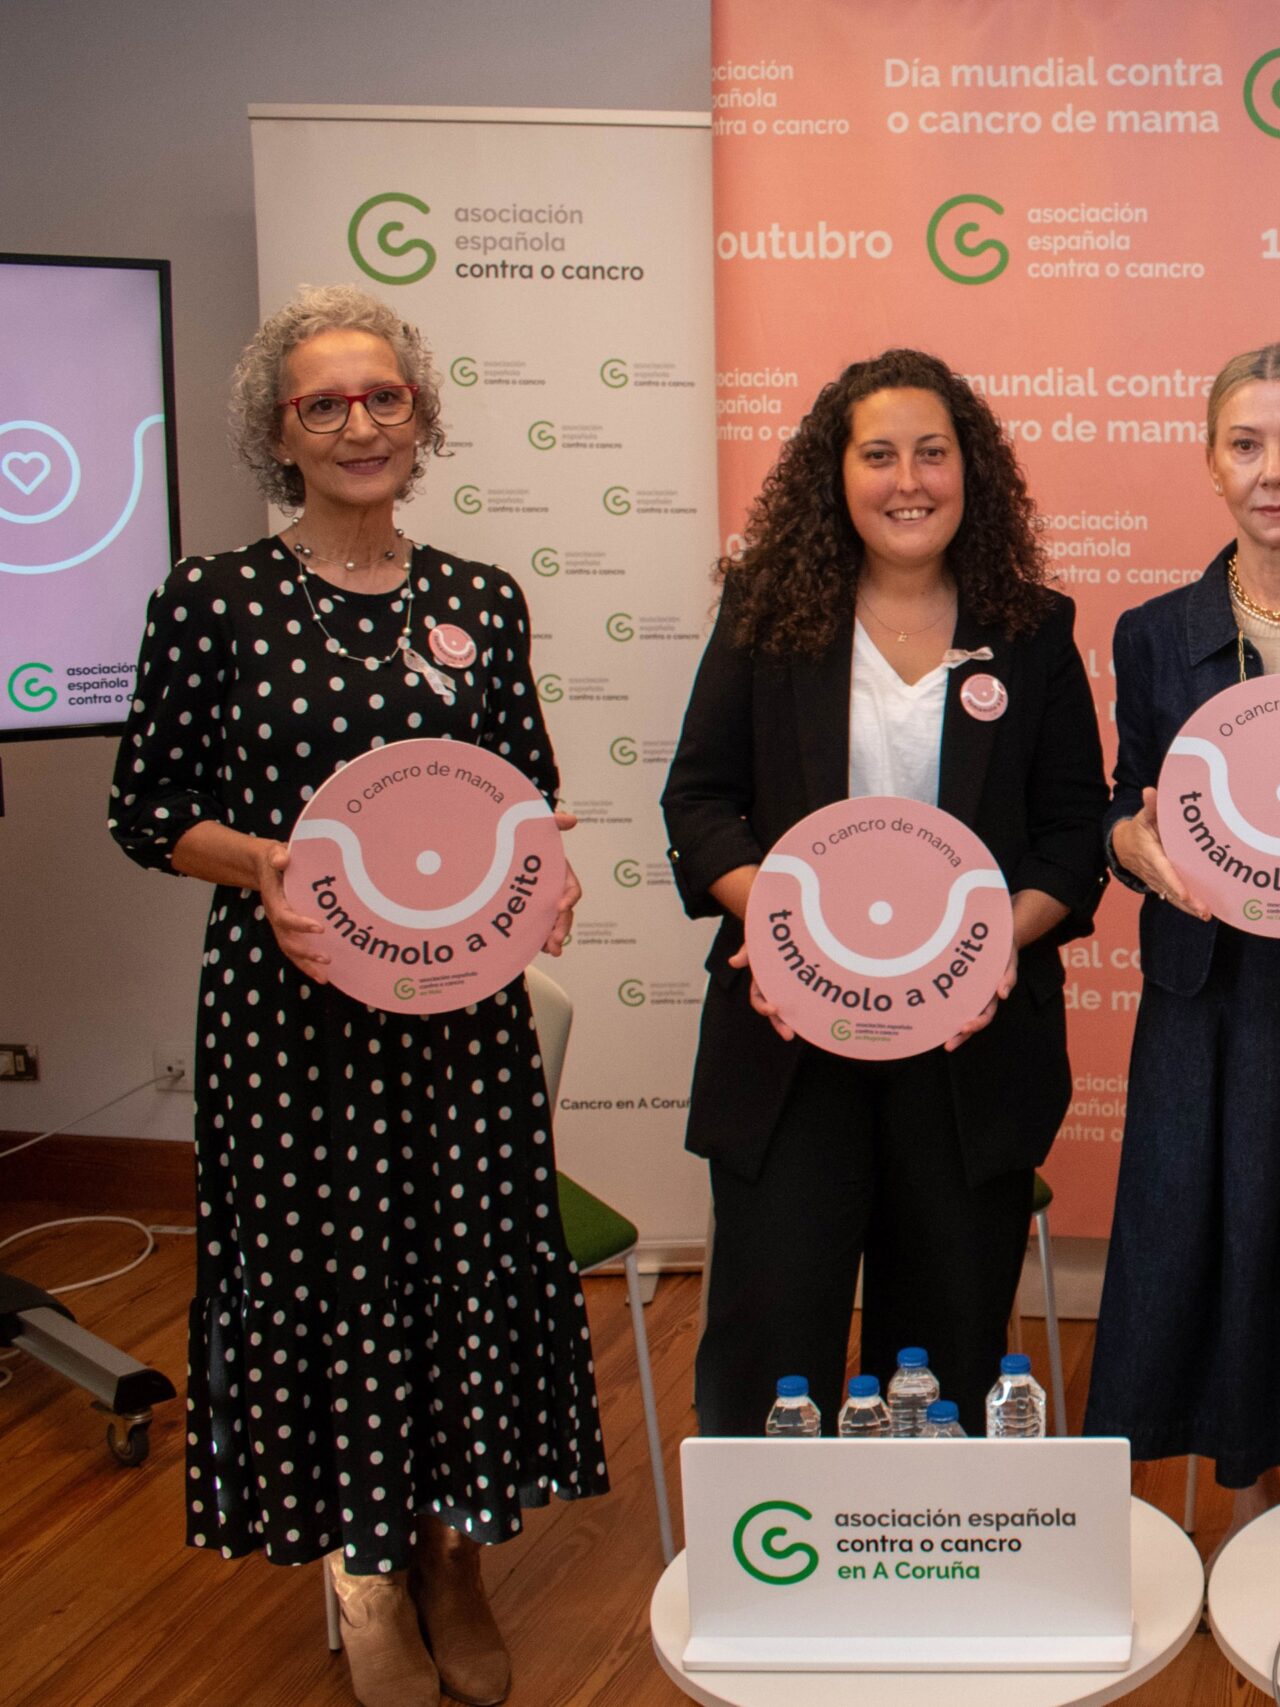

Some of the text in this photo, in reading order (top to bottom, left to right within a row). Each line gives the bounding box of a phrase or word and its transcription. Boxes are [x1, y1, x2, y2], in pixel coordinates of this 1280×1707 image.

[886, 57, 1223, 88] Día mundial contra
[753, 120, 767, 134] o
[772, 119, 850, 135] cancro
[886, 103, 1220, 134] o cancro de mama
[454, 203, 583, 225] asociación
[1028, 203, 1148, 223] asociación
[454, 231, 566, 256] española
[717, 222, 893, 260] outubro
[1028, 231, 1131, 254] española
[455, 259, 644, 281] contra o cancro
[1028, 259, 1205, 279] contra o cancro
[718, 423, 753, 441] ntra
[758, 426, 773, 442] o
[1052, 412, 1097, 443] de
[1045, 538, 1131, 560] spañola
[1056, 565, 1101, 584] ntra
[1107, 568, 1121, 584] o
[67, 662, 138, 677] asociación
[68, 677, 129, 693] española
[68, 694, 112, 706] contra
[114, 694, 124, 703] o
[1219, 723, 1234, 737] O
[347, 761, 505, 814] O cancro de mama
[812, 818, 963, 868] O cancro de mama
[311, 854, 542, 965] tomámolo a peito
[768, 909, 989, 1012] tomámolo a peito
[560, 1097, 688, 1111] Cancro en A Coru
[1060, 1123, 1105, 1142] ntra
[834, 1507, 1077, 1532] asociación española
[836, 1535, 1022, 1553] contra o cancro
[837, 1561, 980, 1580] en A Coruña
